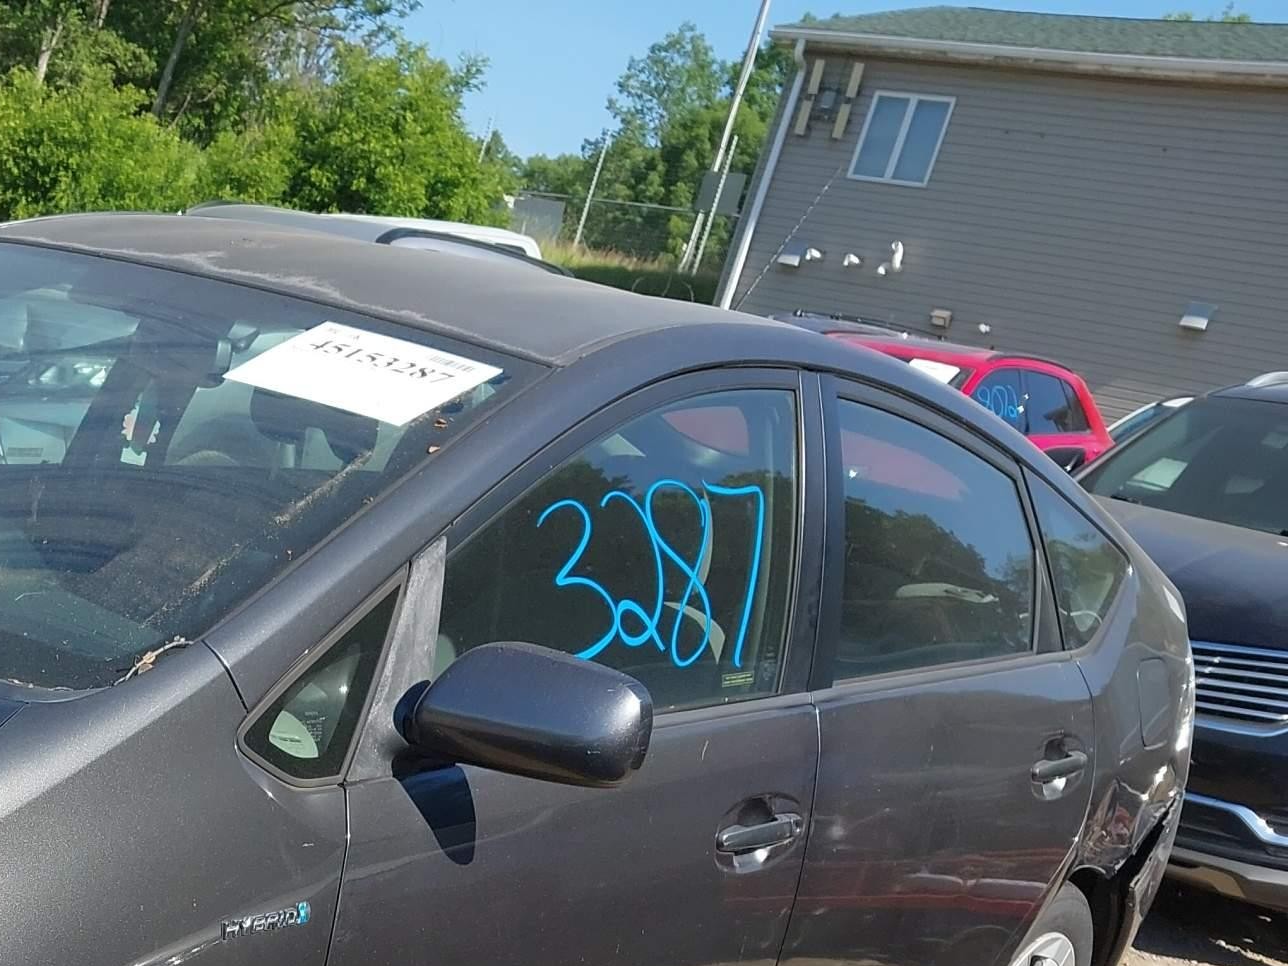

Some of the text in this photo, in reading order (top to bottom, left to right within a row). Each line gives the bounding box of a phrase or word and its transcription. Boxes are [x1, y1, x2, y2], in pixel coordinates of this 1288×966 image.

[310, 340, 456, 384] 45153287
[536, 478, 765, 669] 3287
[221, 908, 298, 940] HYBRID
